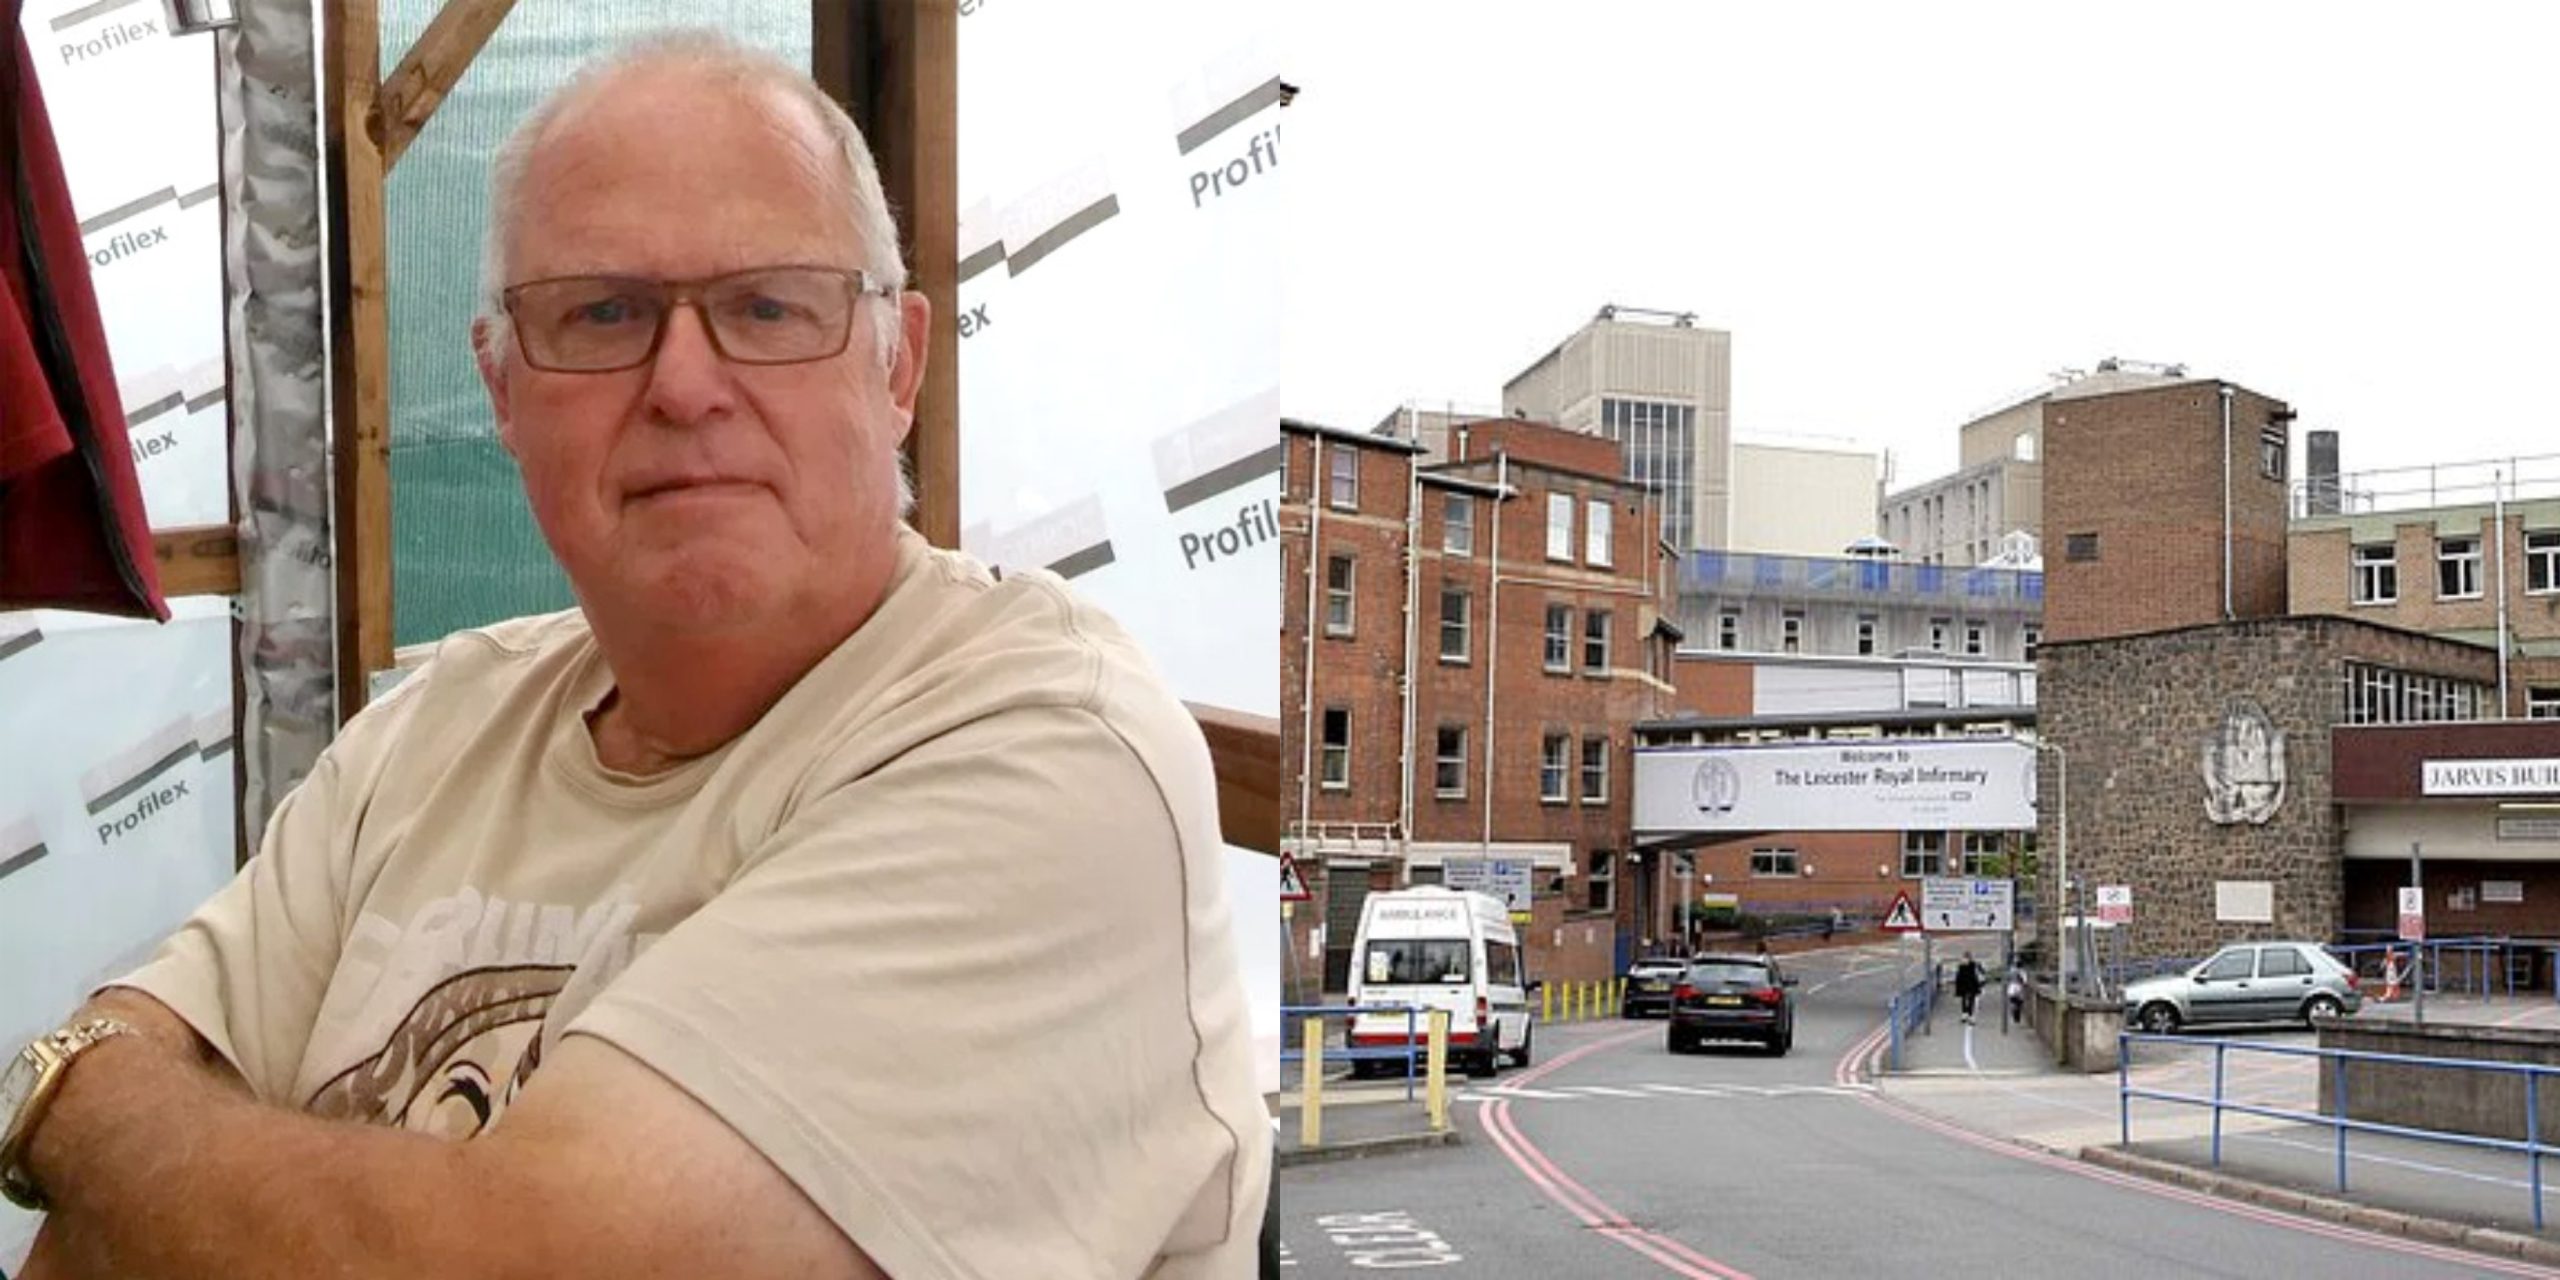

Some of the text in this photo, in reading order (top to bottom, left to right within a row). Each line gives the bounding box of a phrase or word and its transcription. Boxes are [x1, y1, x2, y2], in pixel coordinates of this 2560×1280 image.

[60, 18, 159, 66] Profilex
[1179, 499, 1280, 570] Profil
[1841, 748, 1911, 763] Welcome to
[1775, 766, 1989, 789] The Leicester Royal Infirmary
[2429, 765, 2507, 787] JARVIS
[97, 779, 190, 846] Profilex
